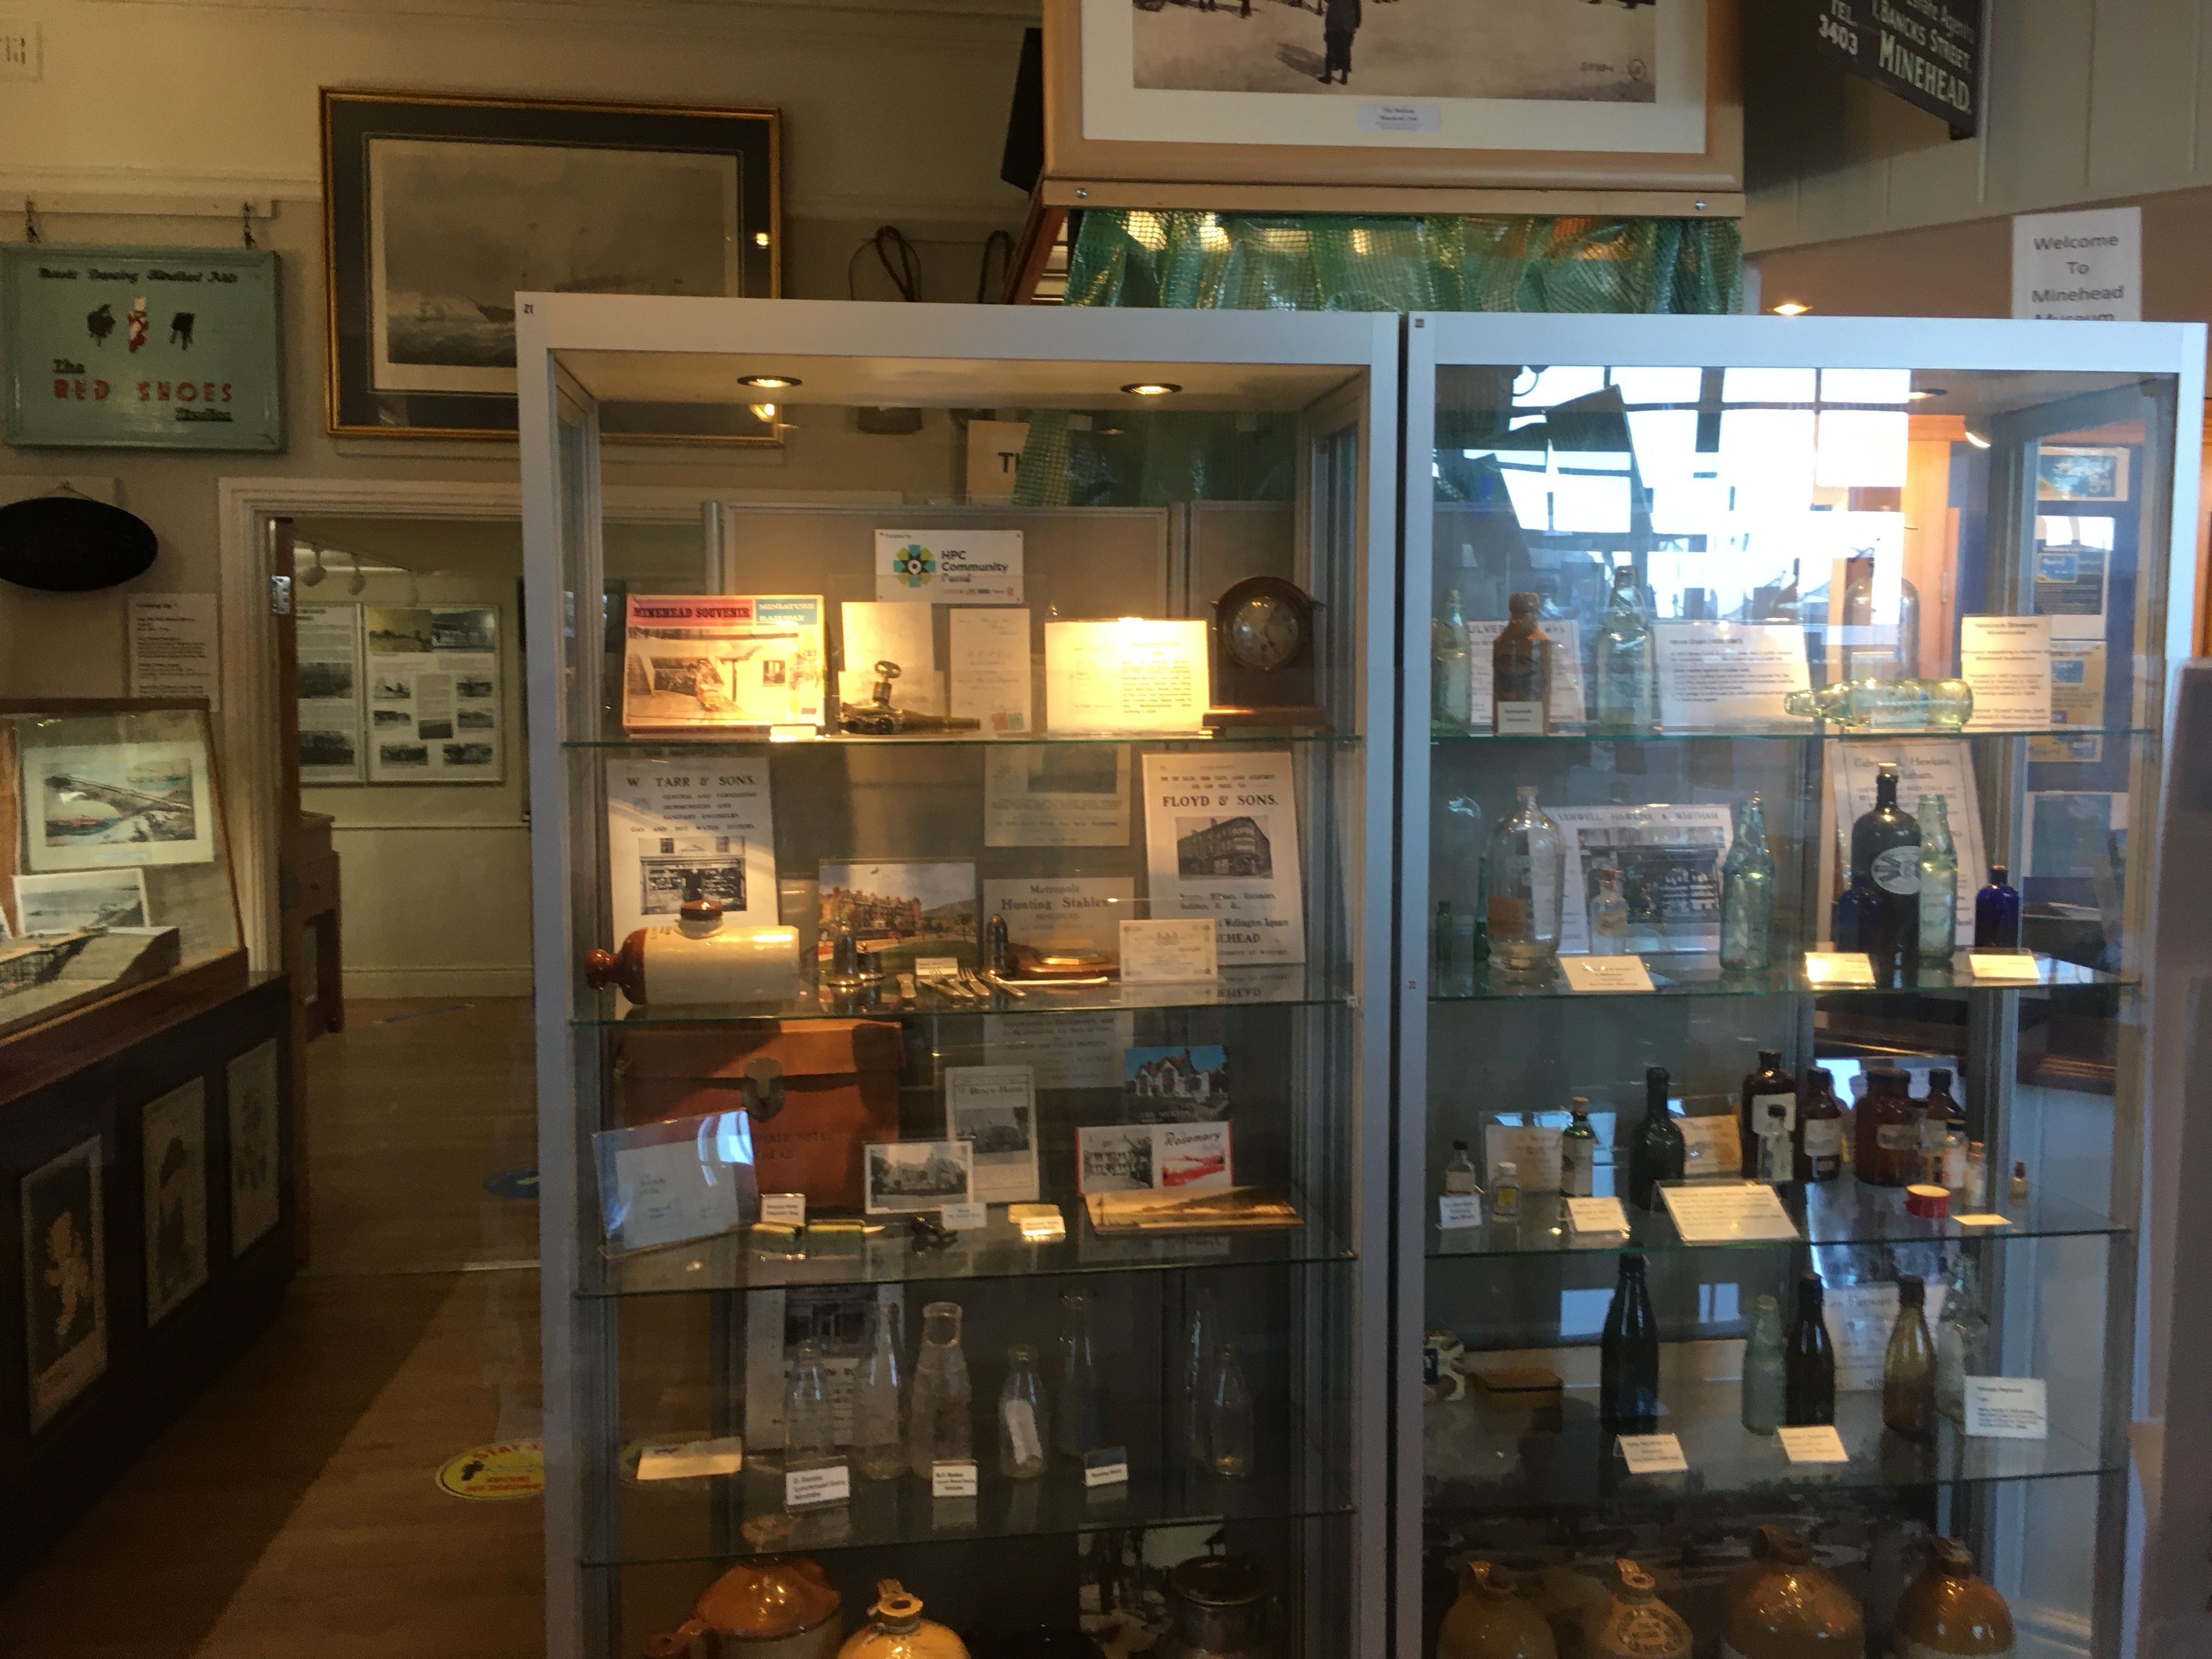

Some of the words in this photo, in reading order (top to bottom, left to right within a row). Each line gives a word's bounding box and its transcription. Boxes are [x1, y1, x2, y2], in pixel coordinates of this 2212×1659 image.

[1819, 14, 1858, 55] 3403
[2033, 235, 2119, 250] Welcome
[2066, 262, 2090, 274] To
[2032, 285, 2124, 303] Minehead
[54, 379, 109, 399] RED
[138, 380, 232, 401] SHOES
[941, 550, 966, 560] HPC
[941, 562, 1008, 574] Community
[633, 607, 692, 618] MINEHEAD
[695, 607, 750, 618] SOUVENIR
[656, 777, 690, 787] TARR
[1163, 796, 1210, 807] FLOYD
[1001, 899, 1052, 911] Hunting
[1164, 1132, 1222, 1146] Rosemary
